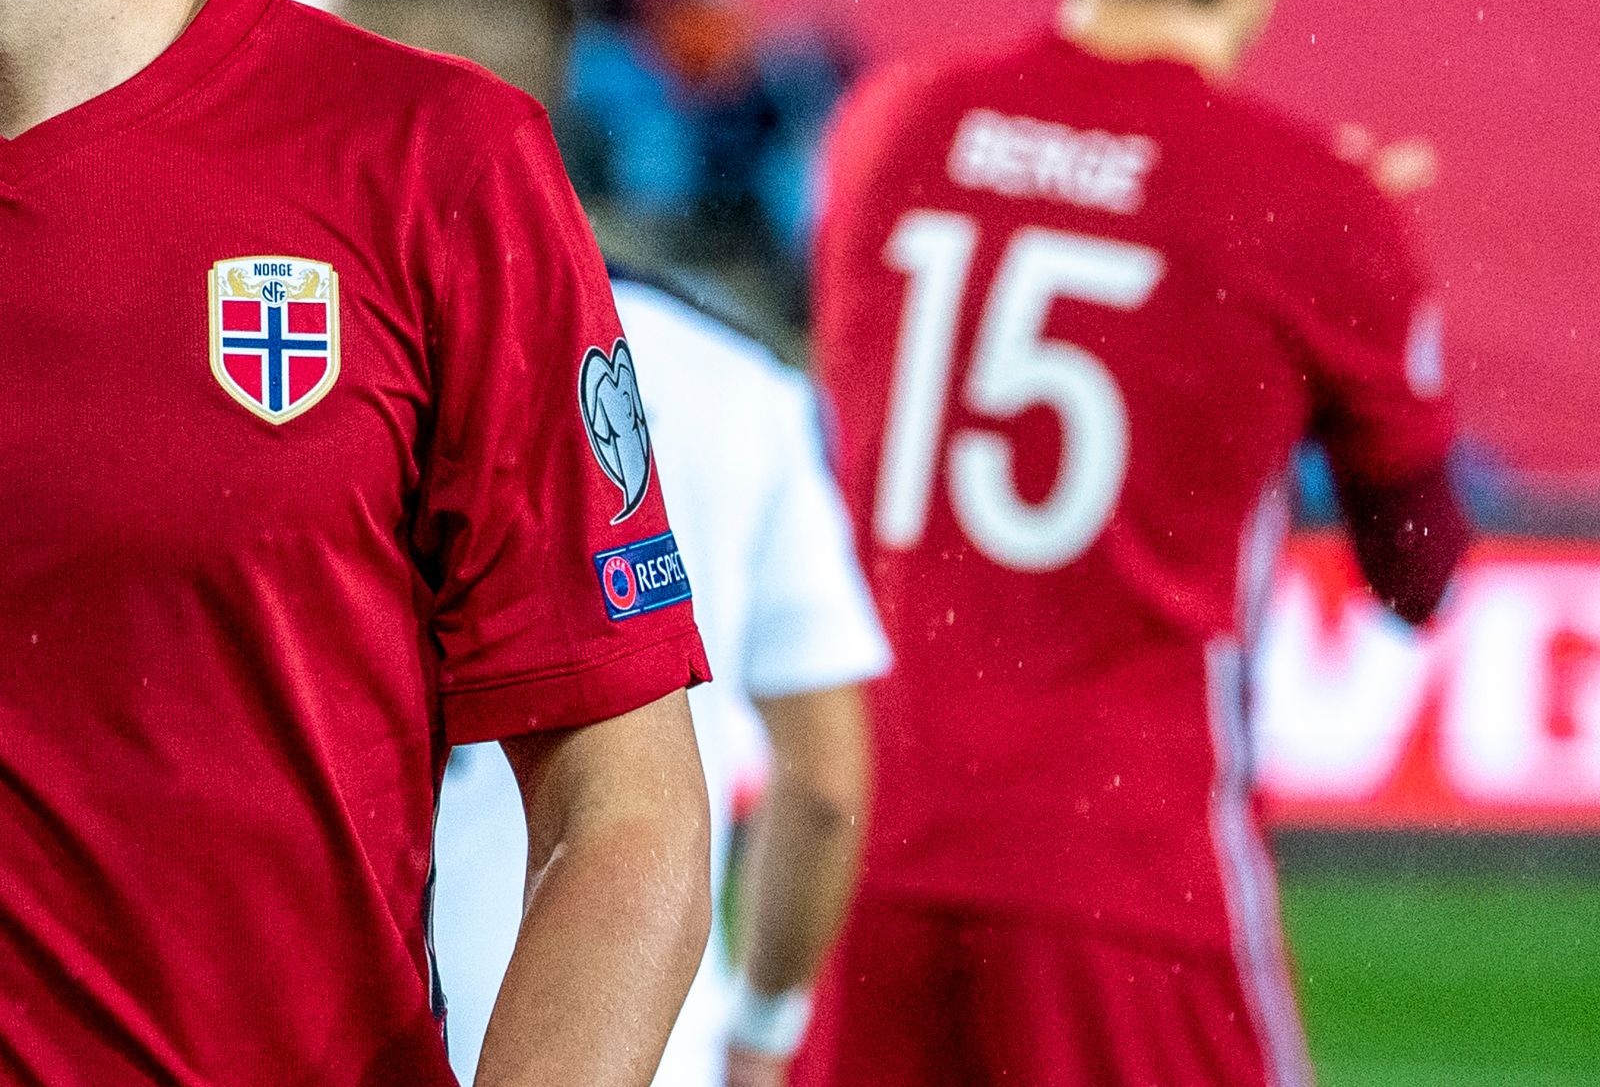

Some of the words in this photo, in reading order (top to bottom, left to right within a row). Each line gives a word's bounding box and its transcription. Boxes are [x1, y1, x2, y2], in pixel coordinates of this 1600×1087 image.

[950, 110, 1156, 214] BERGE
[254, 263, 293, 277] NORGE
[871, 210, 1166, 571] 15
